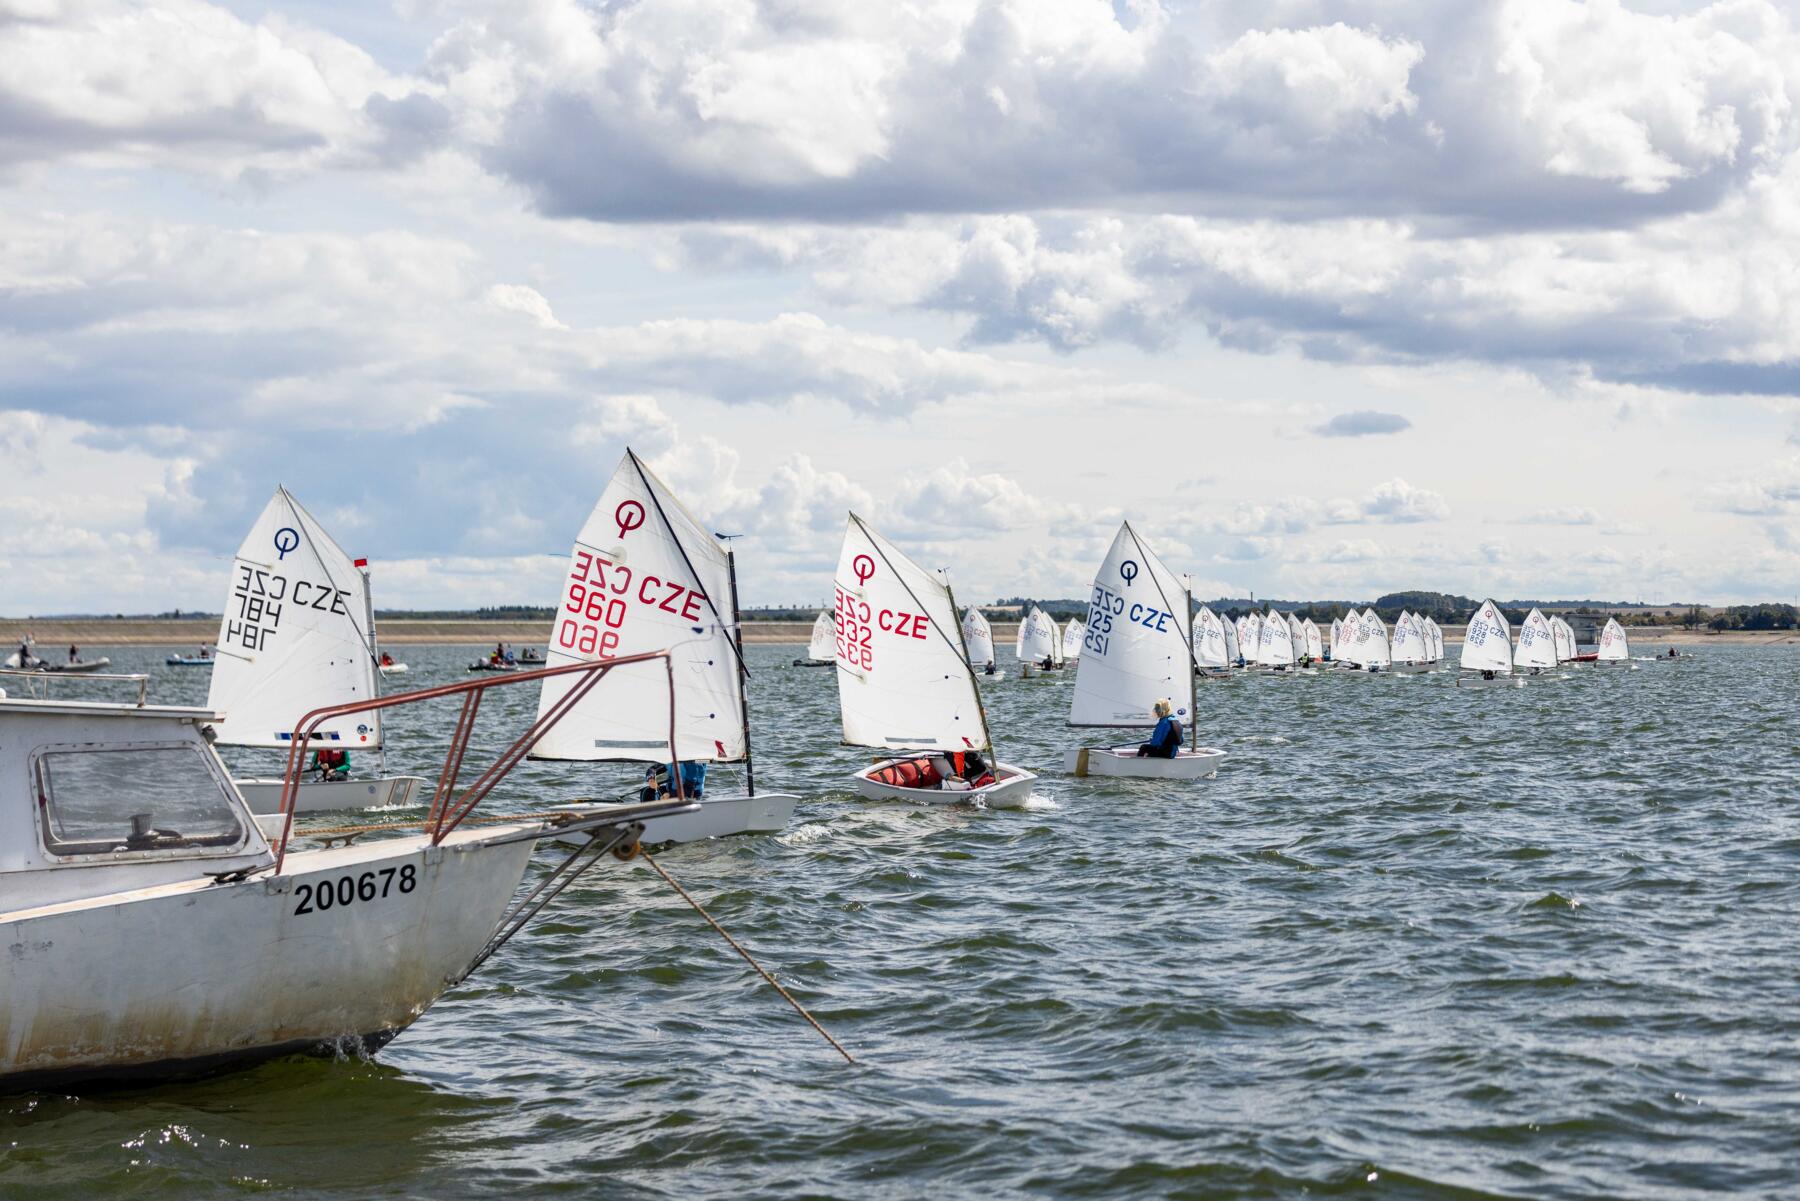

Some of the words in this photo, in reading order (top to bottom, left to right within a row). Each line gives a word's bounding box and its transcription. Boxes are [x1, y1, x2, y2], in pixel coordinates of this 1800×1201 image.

[235, 592, 282, 627] 784
[293, 581, 351, 615] CZE
[566, 583, 626, 629] 960
[638, 575, 707, 622] CZE
[835, 613, 872, 649] 932
[878, 609, 929, 640] CZE
[1087, 608, 1113, 633] 125
[1129, 603, 1173, 633] CZE
[1472, 627, 1487, 638] 928
[1489, 627, 1505, 639] CZE
[1536, 630, 1550, 640] CZE
[293, 863, 417, 916] 200678
